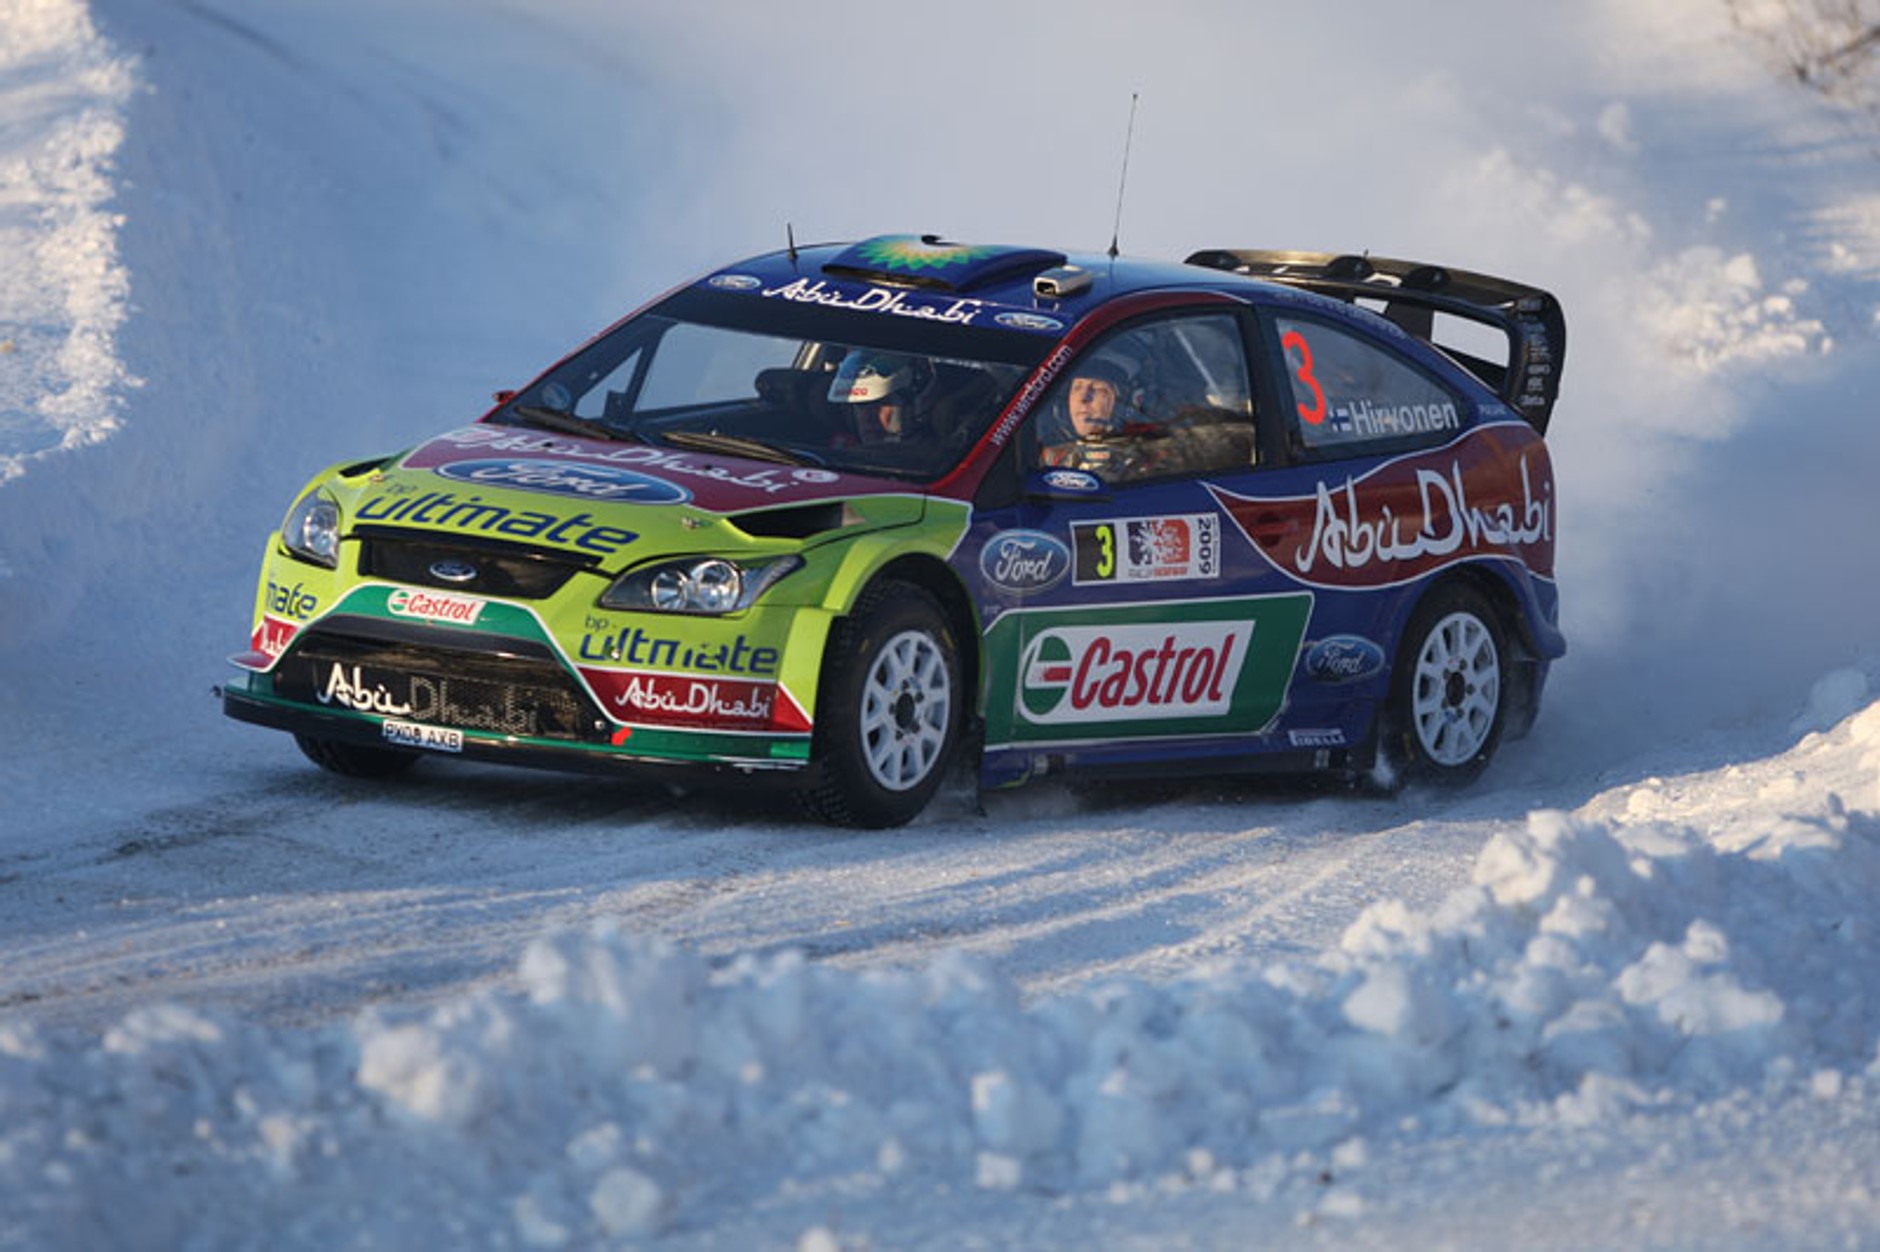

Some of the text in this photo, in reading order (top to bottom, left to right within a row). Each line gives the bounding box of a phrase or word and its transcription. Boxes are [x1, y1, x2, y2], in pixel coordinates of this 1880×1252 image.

[1281, 331, 1326, 426] 3
[1349, 400, 1460, 435] Hirvonen
[471, 464, 650, 495] Ford
[354, 491, 641, 553] ultimate
[1198, 517, 1212, 574] 2009
[995, 538, 1053, 581] Ford
[1096, 525, 1114, 577] 3
[407, 593, 477, 621] Castrol
[1071, 633, 1236, 711] Castrol
